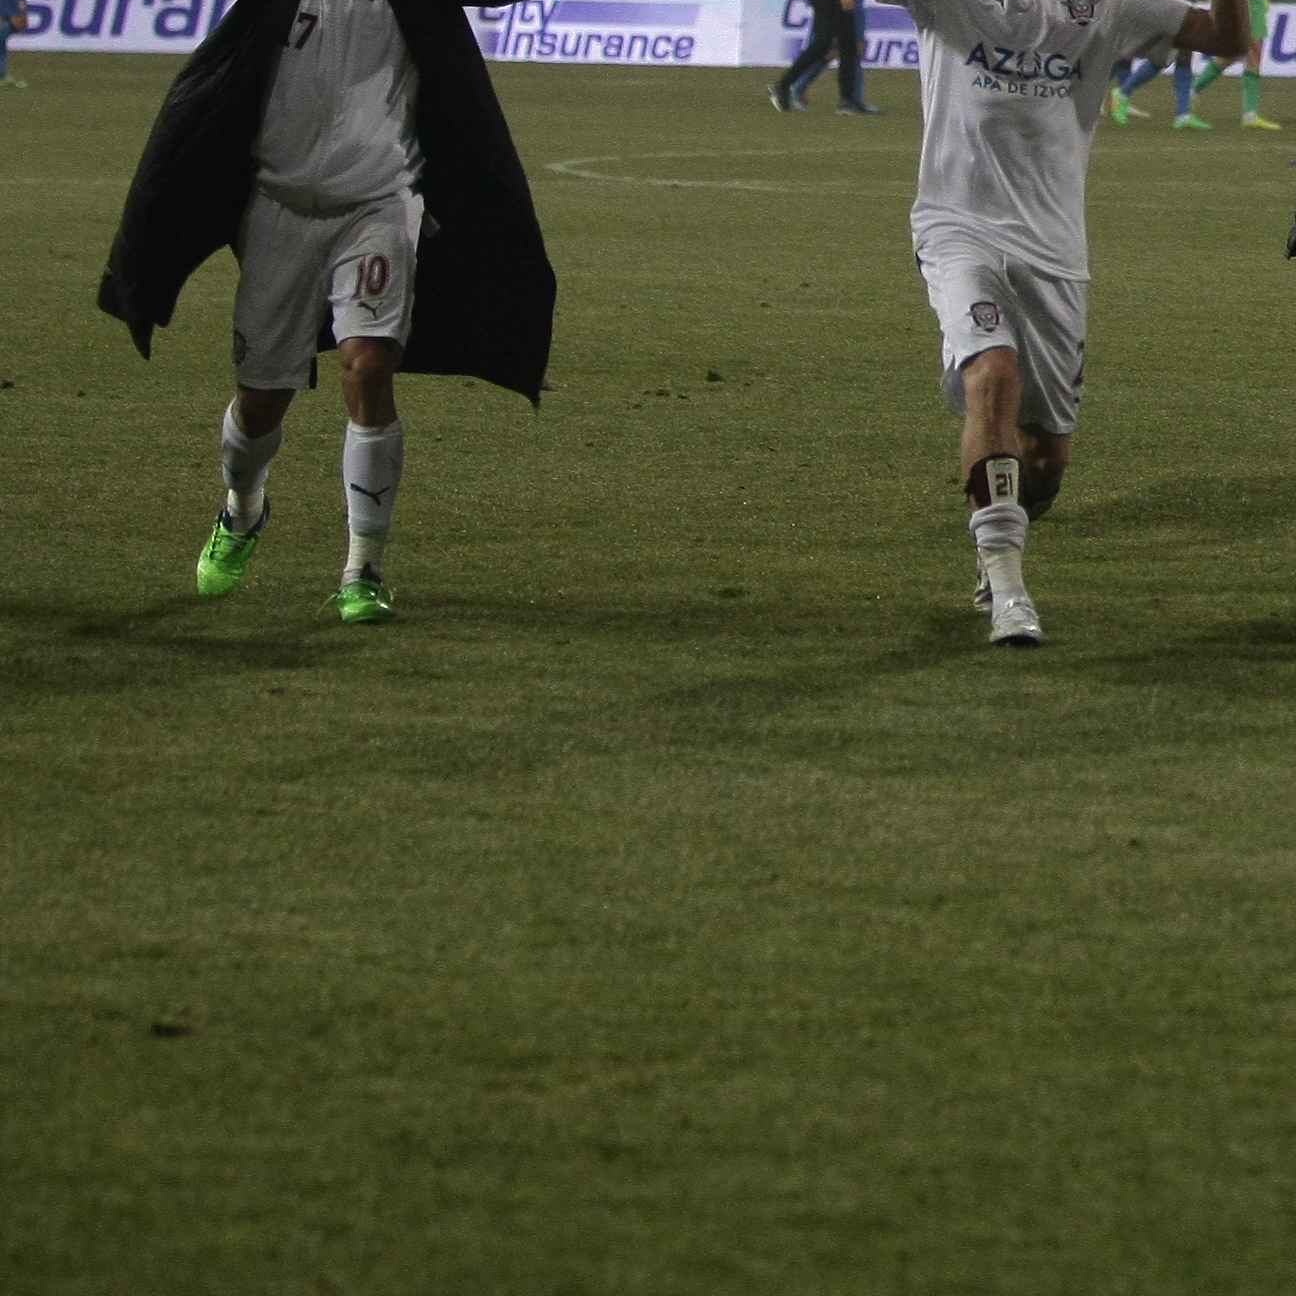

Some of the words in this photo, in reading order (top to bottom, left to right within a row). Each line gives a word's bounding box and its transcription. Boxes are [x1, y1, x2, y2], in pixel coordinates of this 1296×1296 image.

[292, 12, 318, 50] 7
[966, 42, 1082, 81] AZUGA
[971, 76, 1001, 92] APA
[1008, 82, 1027, 96] DE
[354, 255, 389, 299] 10
[995, 473, 1013, 496] 21
